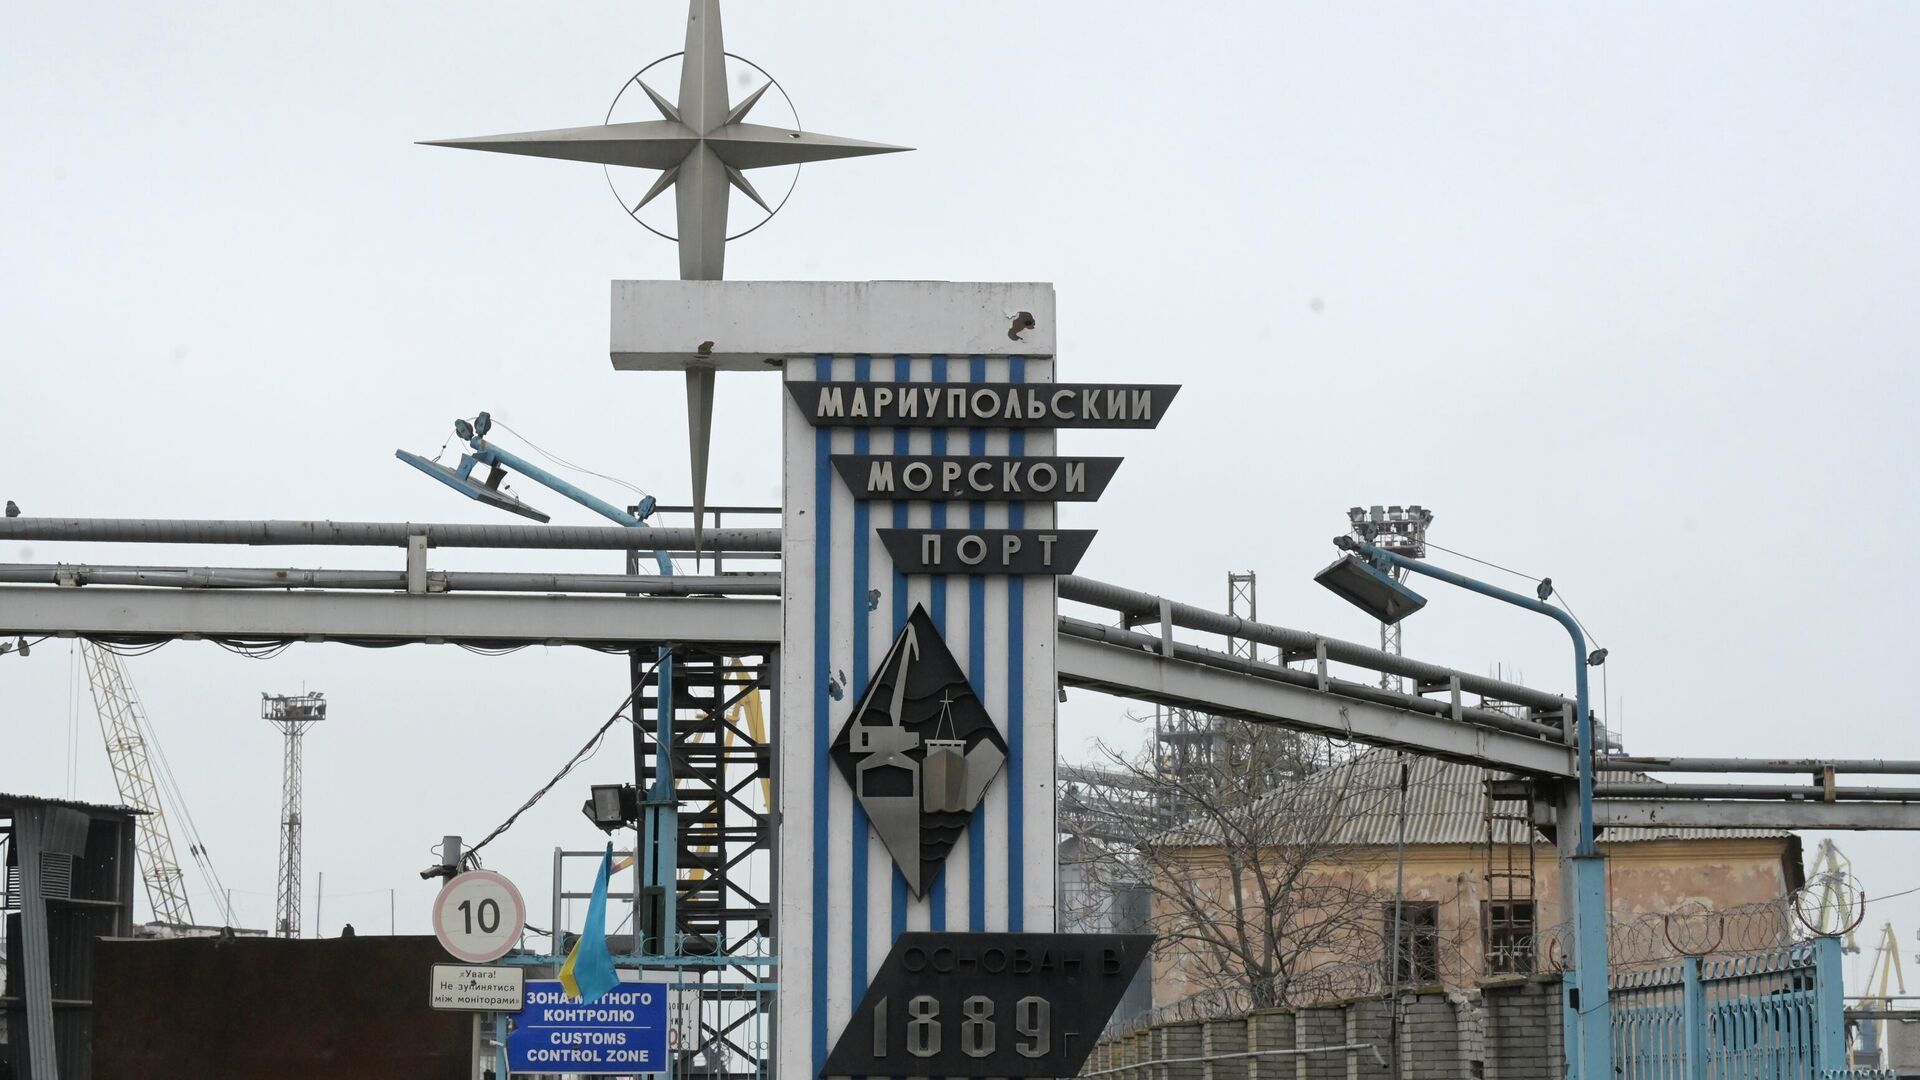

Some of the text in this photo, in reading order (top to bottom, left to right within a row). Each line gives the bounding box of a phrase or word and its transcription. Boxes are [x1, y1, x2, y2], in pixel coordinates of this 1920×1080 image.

[922, 534, 1057, 566] ПОРТ
[457, 898, 500, 934] 10
[903, 946, 1123, 975] ОСНОВАН В
[440, 981, 453, 990] Не
[434, 994, 453, 1003] між
[526, 992, 652, 1006] ЗОНА МТНОГО
[543, 1009, 635, 1022] КОНТРОЛЮ
[873, 994, 1051, 1058] 1889
[550, 1032, 627, 1045] CUSTOMS
[526, 1049, 649, 1062] CONTROL ZONE
